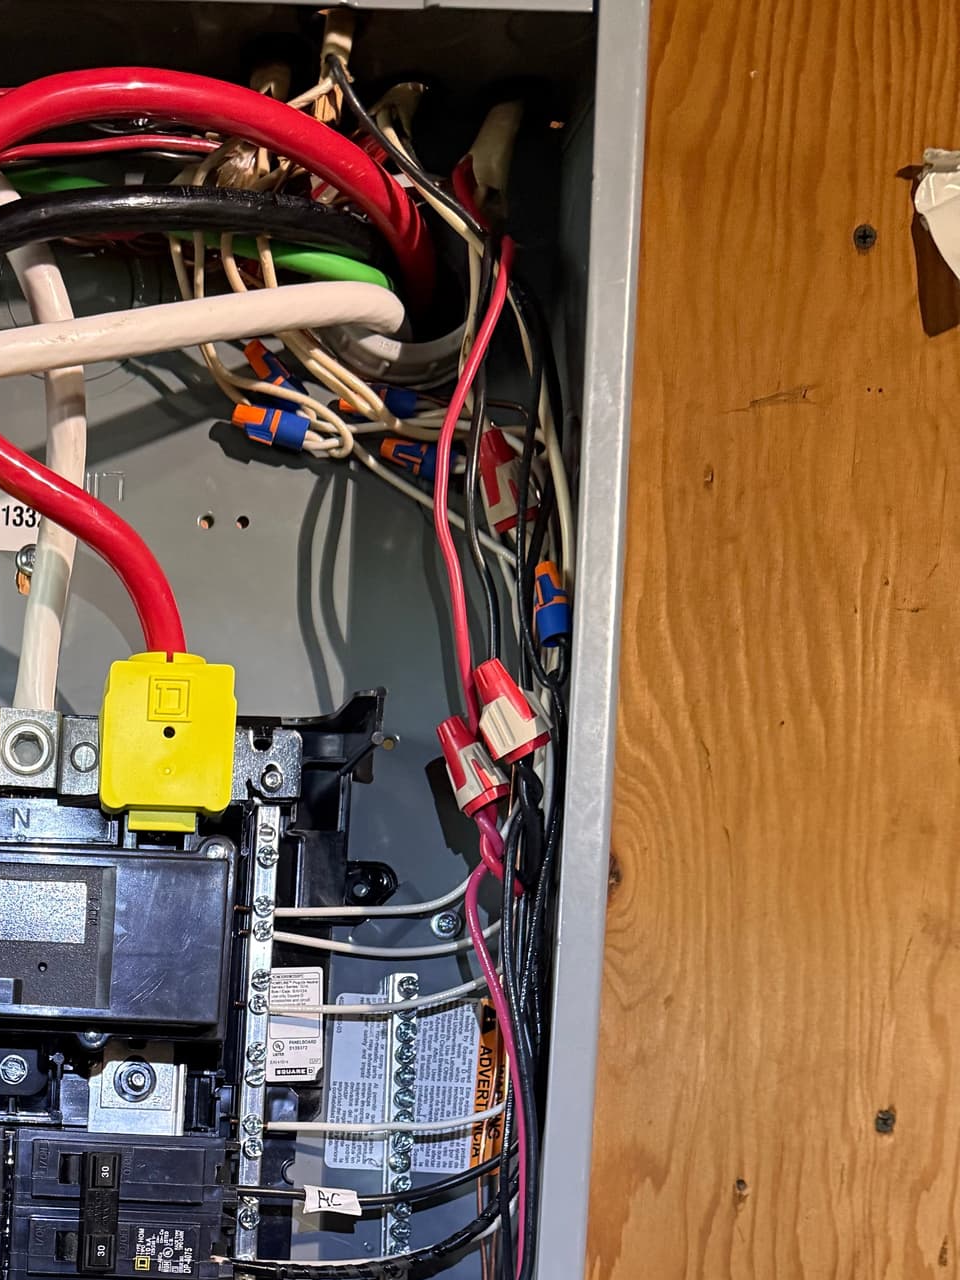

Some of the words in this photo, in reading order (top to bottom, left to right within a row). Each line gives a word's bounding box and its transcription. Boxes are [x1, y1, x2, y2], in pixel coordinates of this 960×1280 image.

[13, 808, 30, 828] N
[472, 1045, 493, 1158] ADVERTNCIA
[101, 1166, 110, 1178] 30
[97, 1244, 106, 1257] 30
